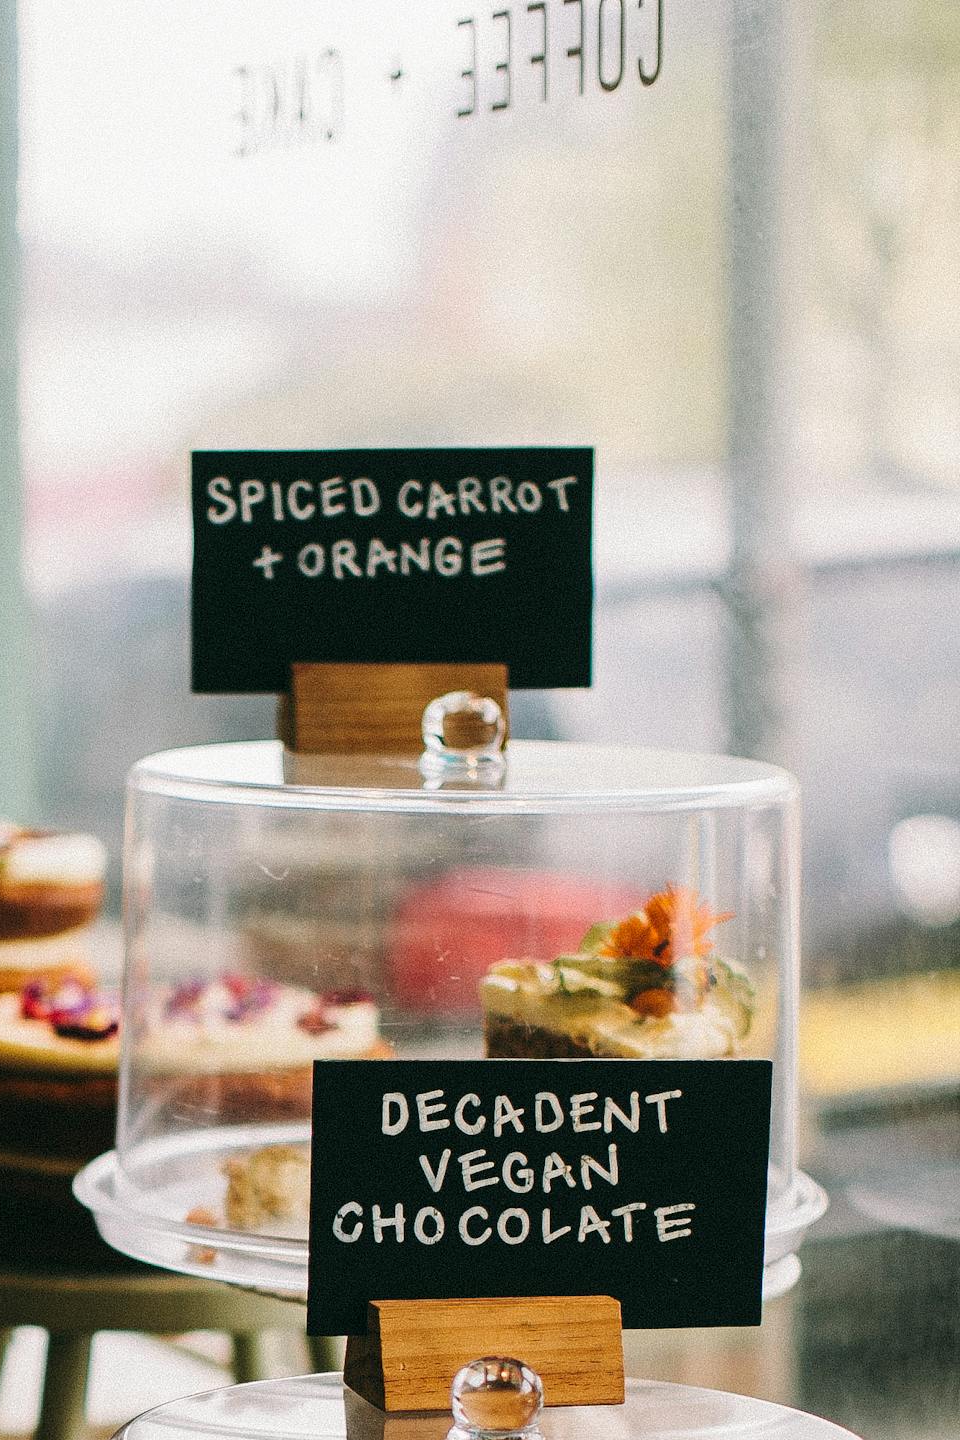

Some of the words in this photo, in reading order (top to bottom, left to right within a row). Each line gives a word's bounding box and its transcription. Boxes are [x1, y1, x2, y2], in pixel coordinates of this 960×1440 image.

[206, 476, 381, 525] SPICED
[397, 475, 578, 520] CARROT
[252, 546, 283, 580] +
[297, 536, 506, 580] ORANGE
[381, 1088, 682, 1137] DECADENT
[419, 1143, 619, 1193] VEGAN
[332, 1201, 696, 1246] CHOCOLATE
